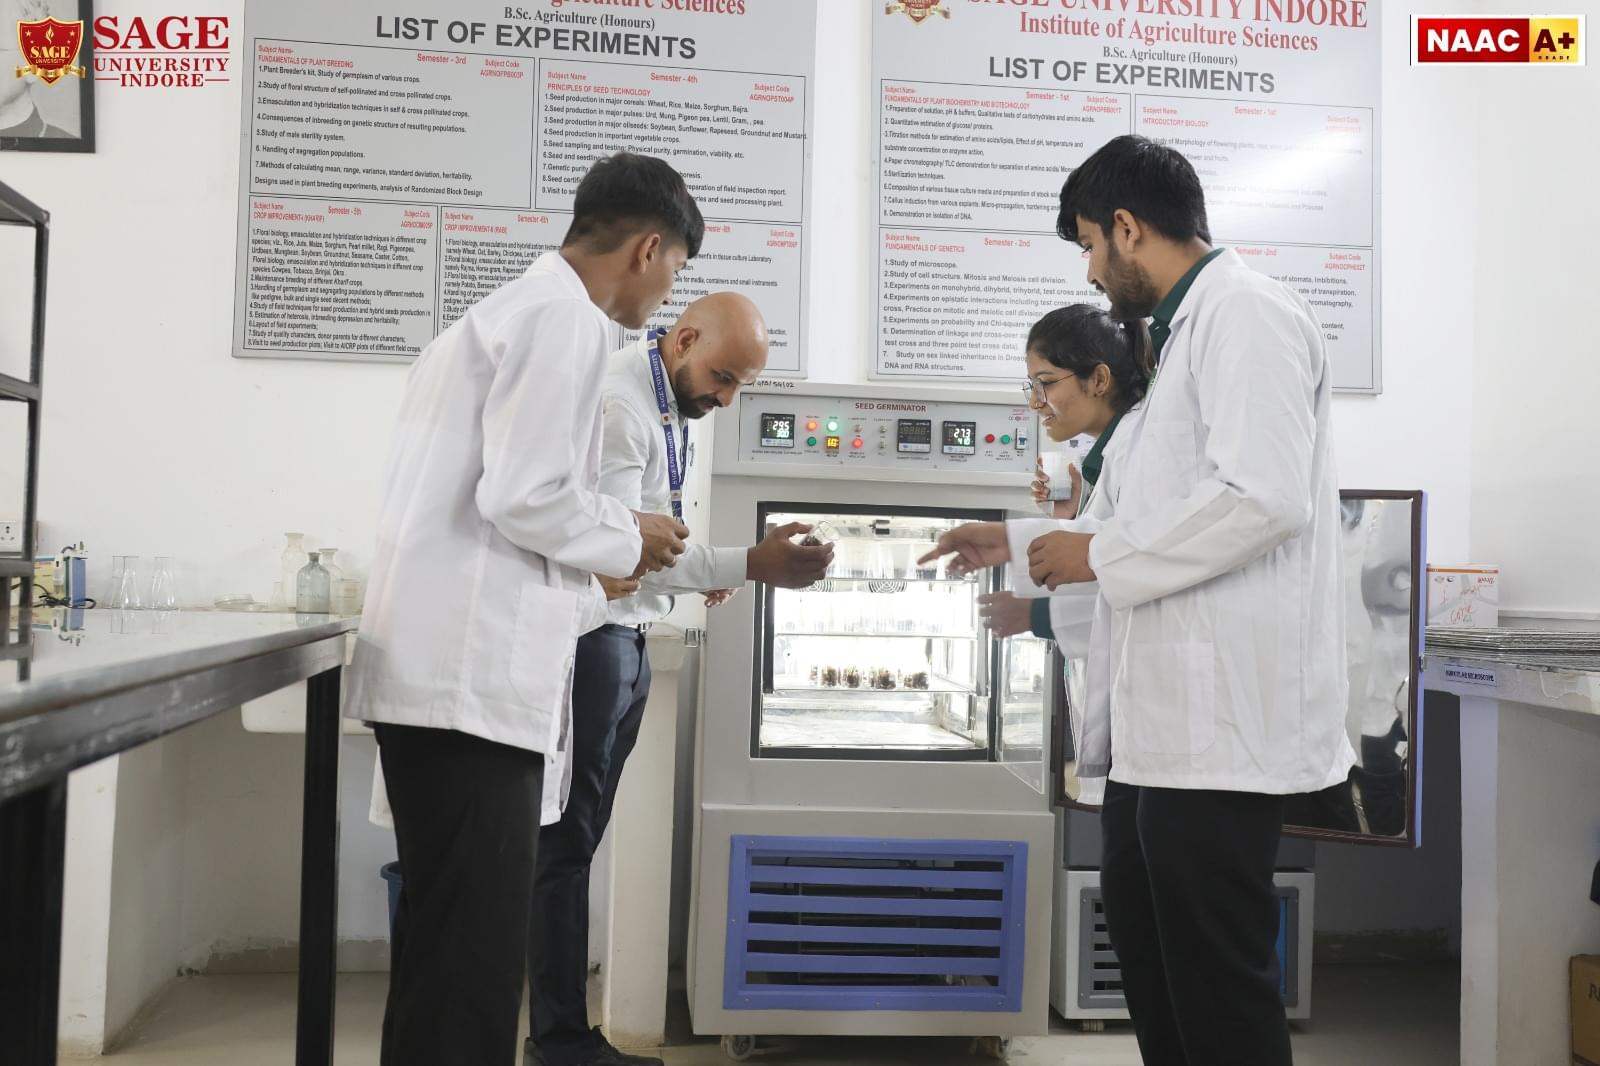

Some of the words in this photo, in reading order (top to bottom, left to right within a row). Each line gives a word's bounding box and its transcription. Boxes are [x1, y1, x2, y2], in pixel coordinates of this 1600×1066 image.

[504, 7, 532, 20] B.Sc.
[534, 10, 597, 25] Agriculture
[600, 14, 655, 31] (Honours)
[377, 16, 438, 40] LIST
[447, 21, 486, 44] OF
[496, 24, 696, 59] EXPERIMENTS
[1020, 12, 1099, 37] Institute
[1105, 16, 1125, 38] of
[1128, 19, 1236, 45] Agriculture
[1242, 26, 1318, 51] Sciences
[258, 54, 300, 64] FUNDAMENTALS
[326, 60, 353, 68] BREEDING
[416, 54, 449, 63] Semester
[1103, 46, 1127, 59] B.Sc.
[1130, 50, 1186, 63] Agriculture
[1188, 51, 1238, 67] (Honours)
[317, 70, 334, 79] Study
[341, 71, 373, 81] germplasm
[650, 73, 681, 82] Semester
[990, 56, 1044, 79] LIST
[1053, 60, 1087, 81] OF
[1096, 63, 1274, 93] EXPERIMENTS
[257, 82, 279, 91] 2.Study
[303, 85, 329, 93] structure
[336, 87, 377, 98] self-pollinated
[406, 91, 434, 101] pollinated
[547, 83, 582, 92] PRINCIPLES
[610, 87, 650, 96] TECHNOLOGY
[256, 129, 278, 138] 5.Study
[300, 132, 322, 141] sterility
[564, 130, 597, 140] production
[604, 132, 633, 142] important
[633, 134, 662, 144] vegetable
[564, 141, 591, 151] sampling
[626, 145, 652, 155] Physical
[672, 148, 708, 158] germination,
[736, 186, 767, 196] inspection
[734, 198, 766, 207] processing
[884, 243, 928, 251] FUNDAMENTALS
[884, 259, 908, 268] 1.Study
[883, 271, 908, 280] 2.Study
[883, 282, 930, 292] 3.Experiments
[941, 284, 981, 294] monohybrid,
[983, 286, 1011, 294] dihybrid,
[1012, 287, 1041, 296] trihybrid,
[876, 403, 926, 412] GERMINATOR
